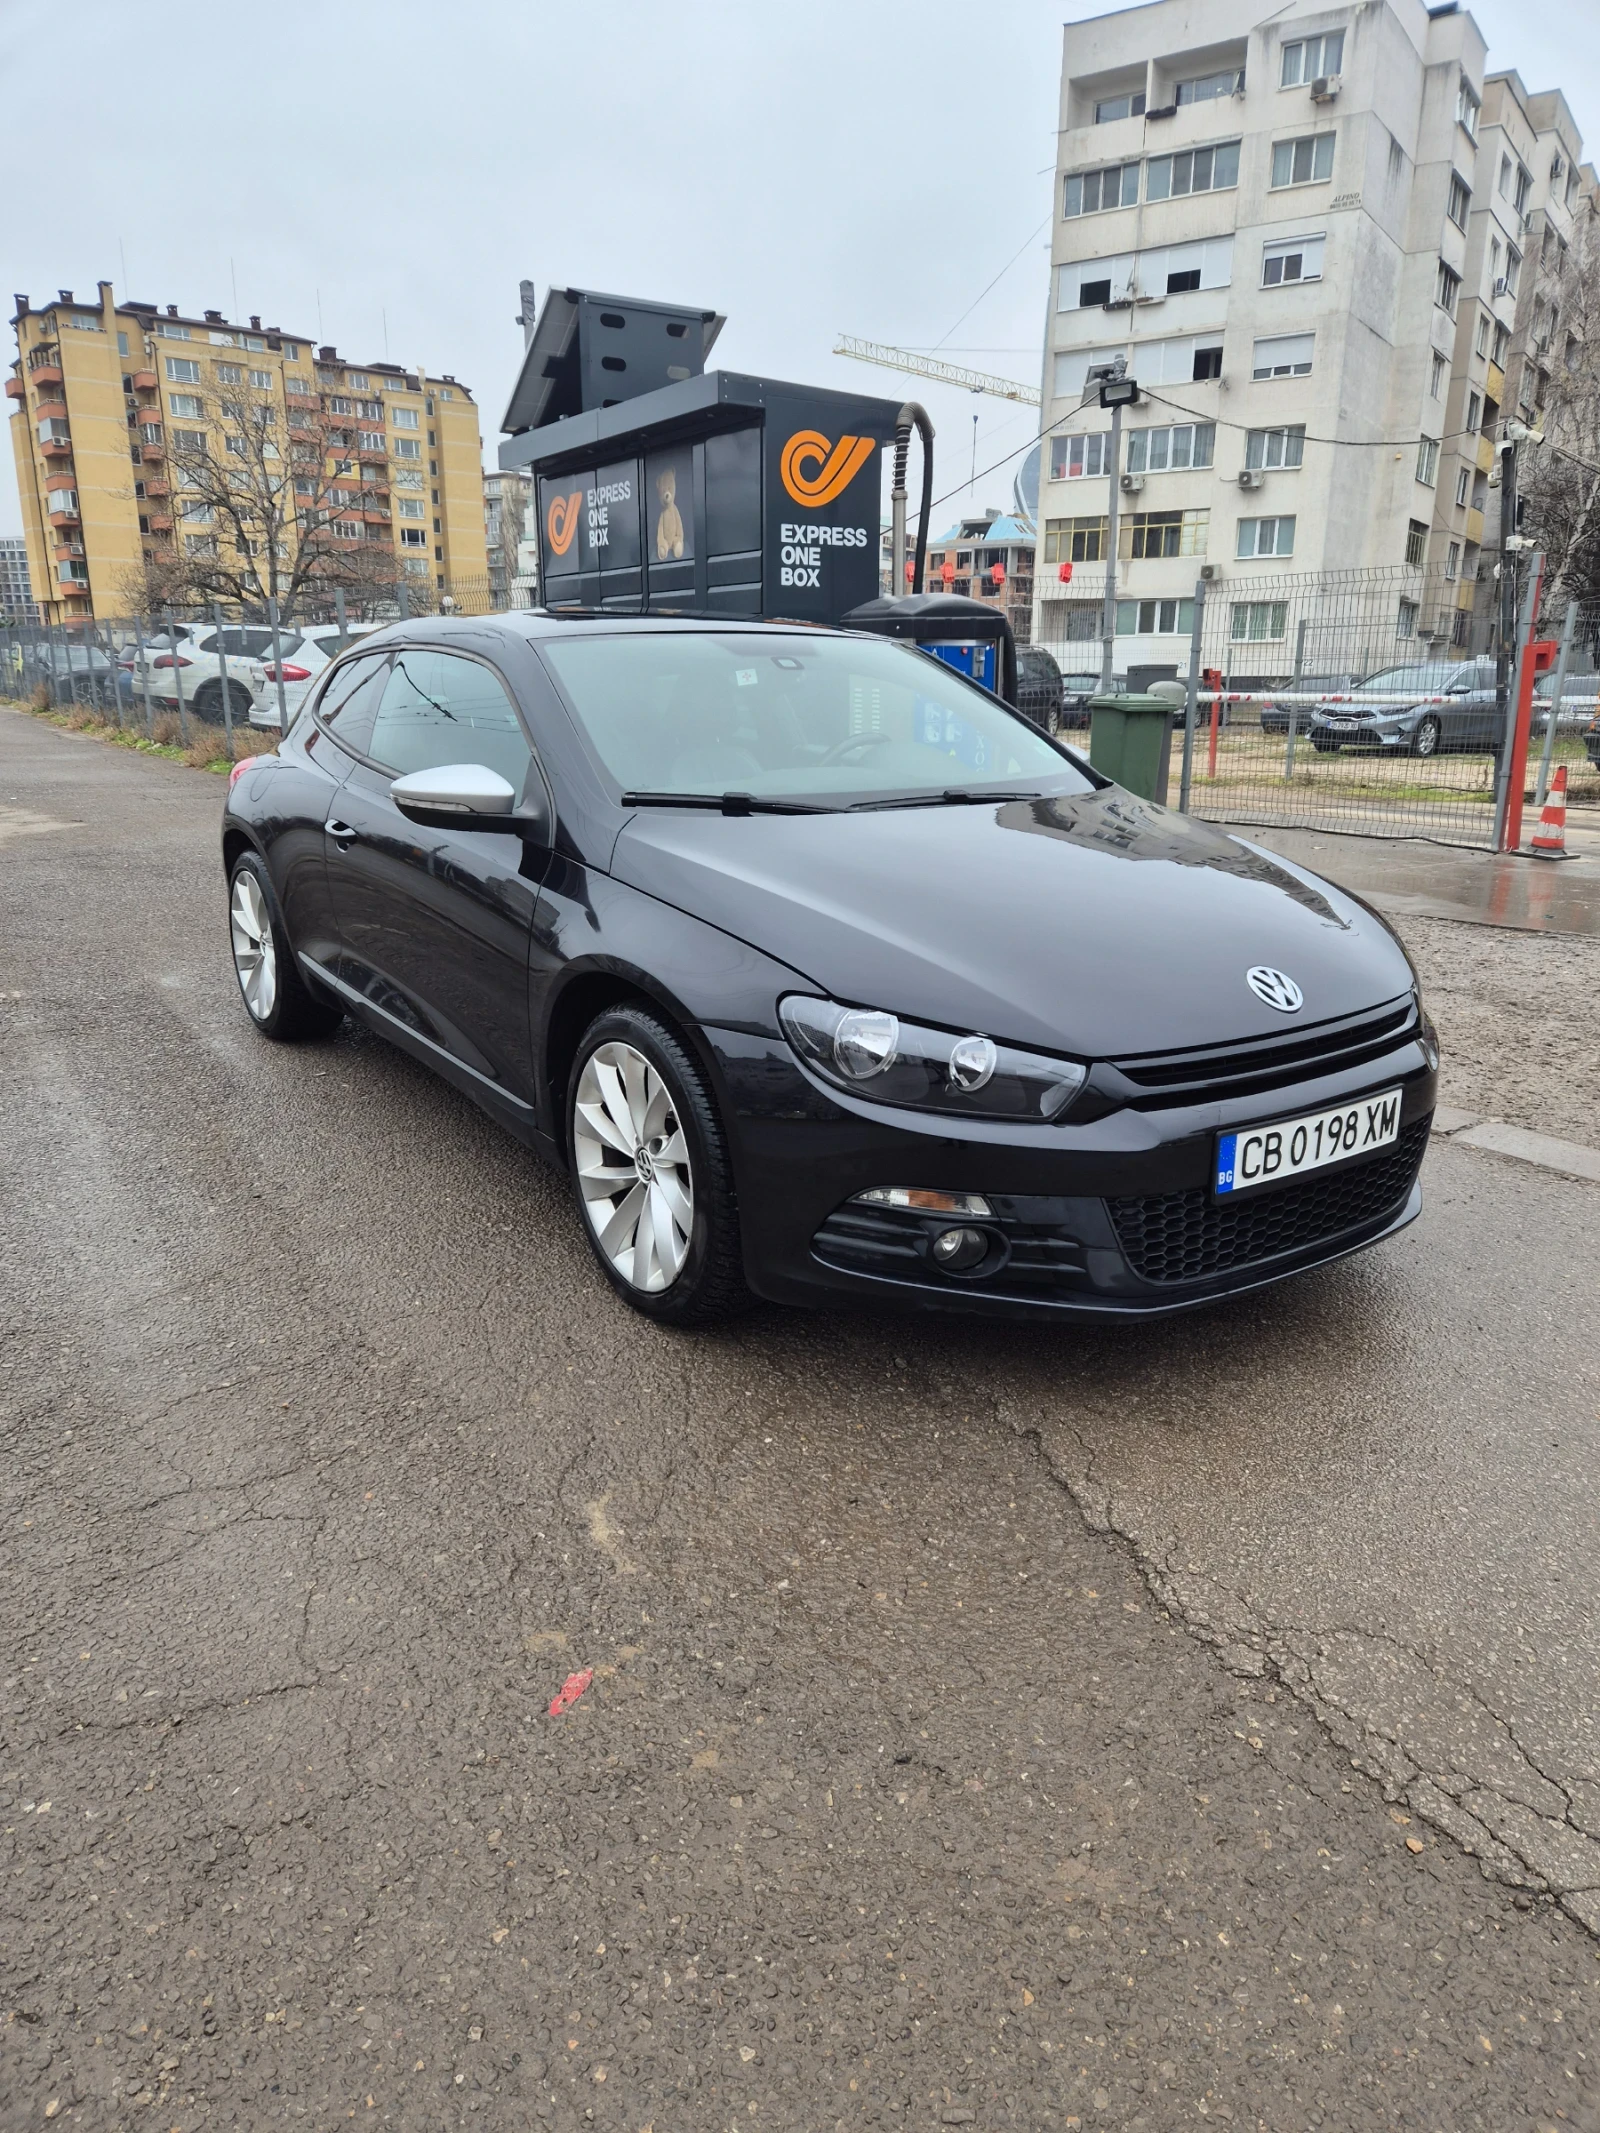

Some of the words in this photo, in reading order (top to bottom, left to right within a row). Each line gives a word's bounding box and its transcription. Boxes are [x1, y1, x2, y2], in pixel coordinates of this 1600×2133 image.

[587, 480, 631, 507] EXPRESS
[588, 507, 608, 527] ONE
[589, 528, 609, 548] BOX
[780, 523, 868, 547] EXPRESS
[781, 545, 821, 566] ONE
[780, 567, 820, 587] BOX
[1178, 661, 1187, 669] 21
[1241, 1131, 1283, 1179] CB
[1290, 1110, 1359, 1166] 0198
[1362, 1097, 1398, 1145] XM
[1217, 1169, 1233, 1185] BG
